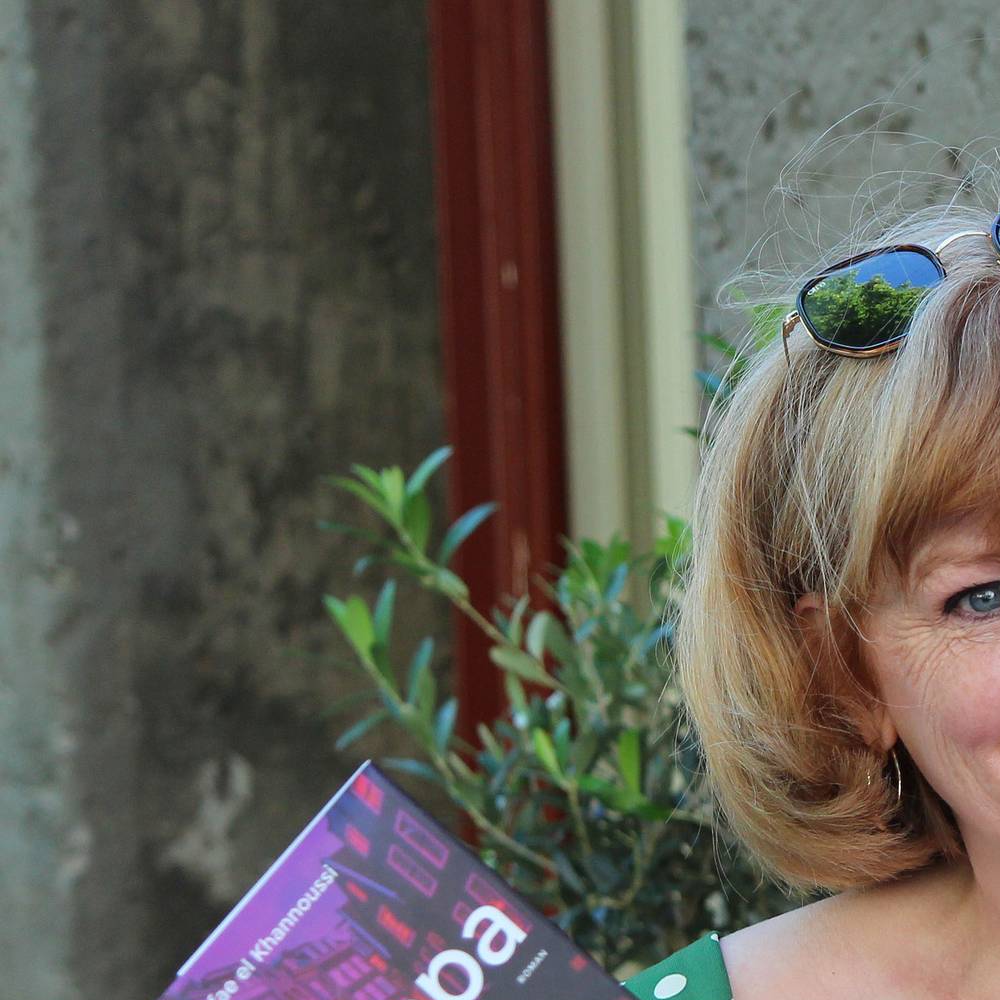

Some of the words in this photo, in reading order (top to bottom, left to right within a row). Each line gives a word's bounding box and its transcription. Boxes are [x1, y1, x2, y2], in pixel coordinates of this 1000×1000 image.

[230, 956, 257, 982] el
[245, 862, 340, 963] Khannoussi
[517, 949, 548, 985] ROMAN
